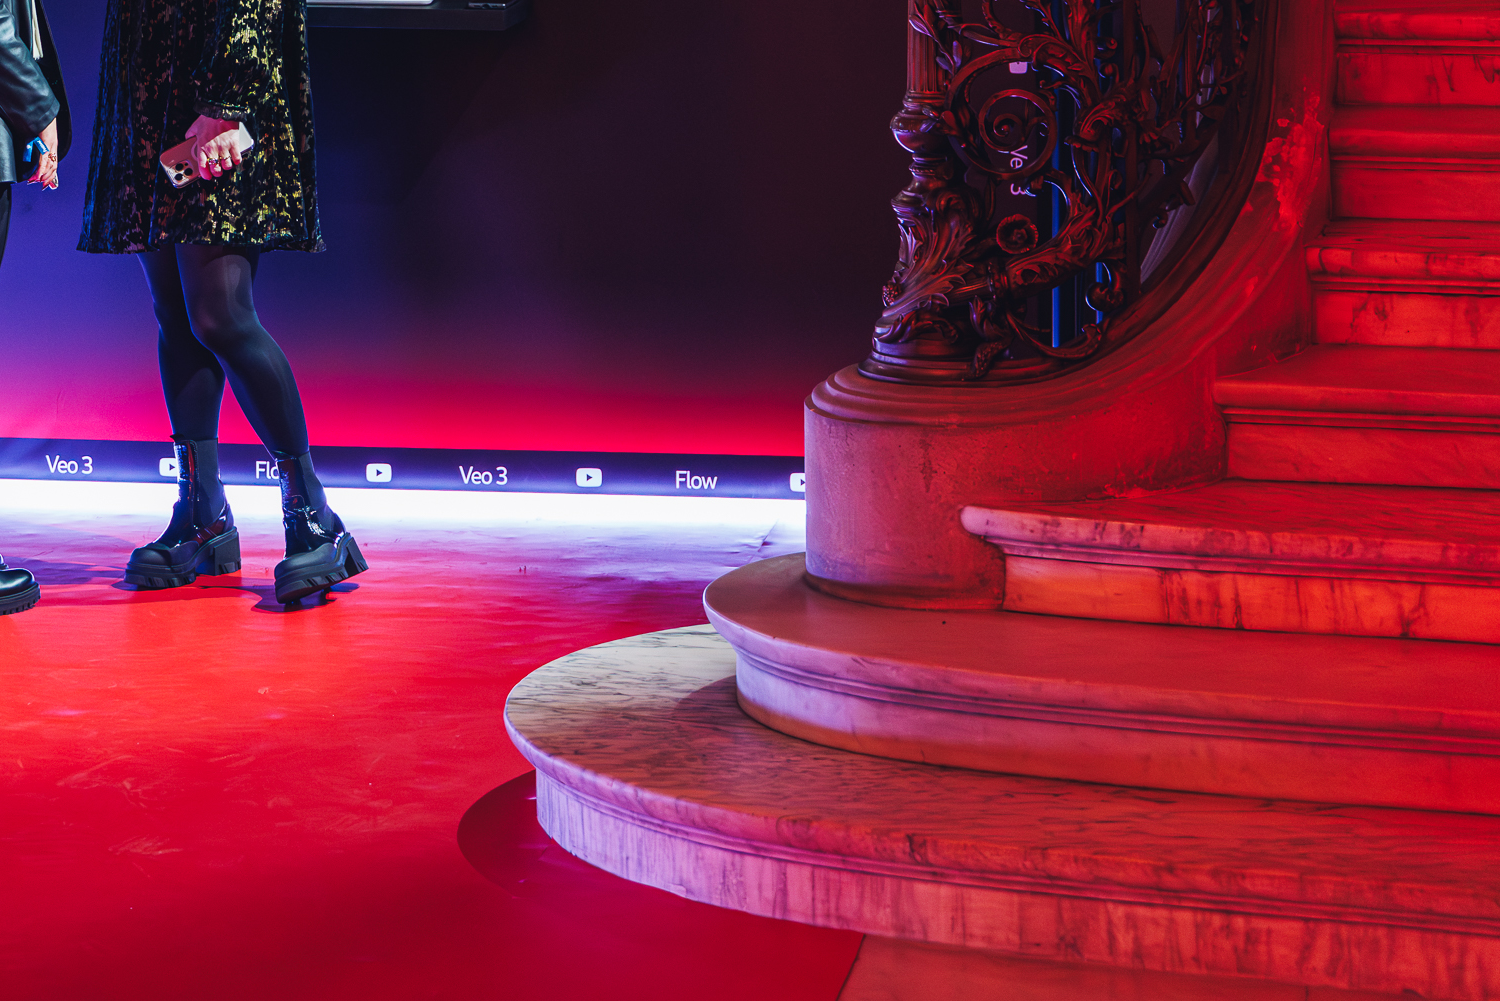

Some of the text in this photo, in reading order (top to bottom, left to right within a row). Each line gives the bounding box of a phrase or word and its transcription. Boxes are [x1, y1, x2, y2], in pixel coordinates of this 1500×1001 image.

[1010, 145, 1028, 170] Ve
[46, 454, 93, 475] Veo 3
[256, 461, 279, 480] Flo
[459, 465, 508, 486] Veo 3
[676, 470, 717, 490] Flow
